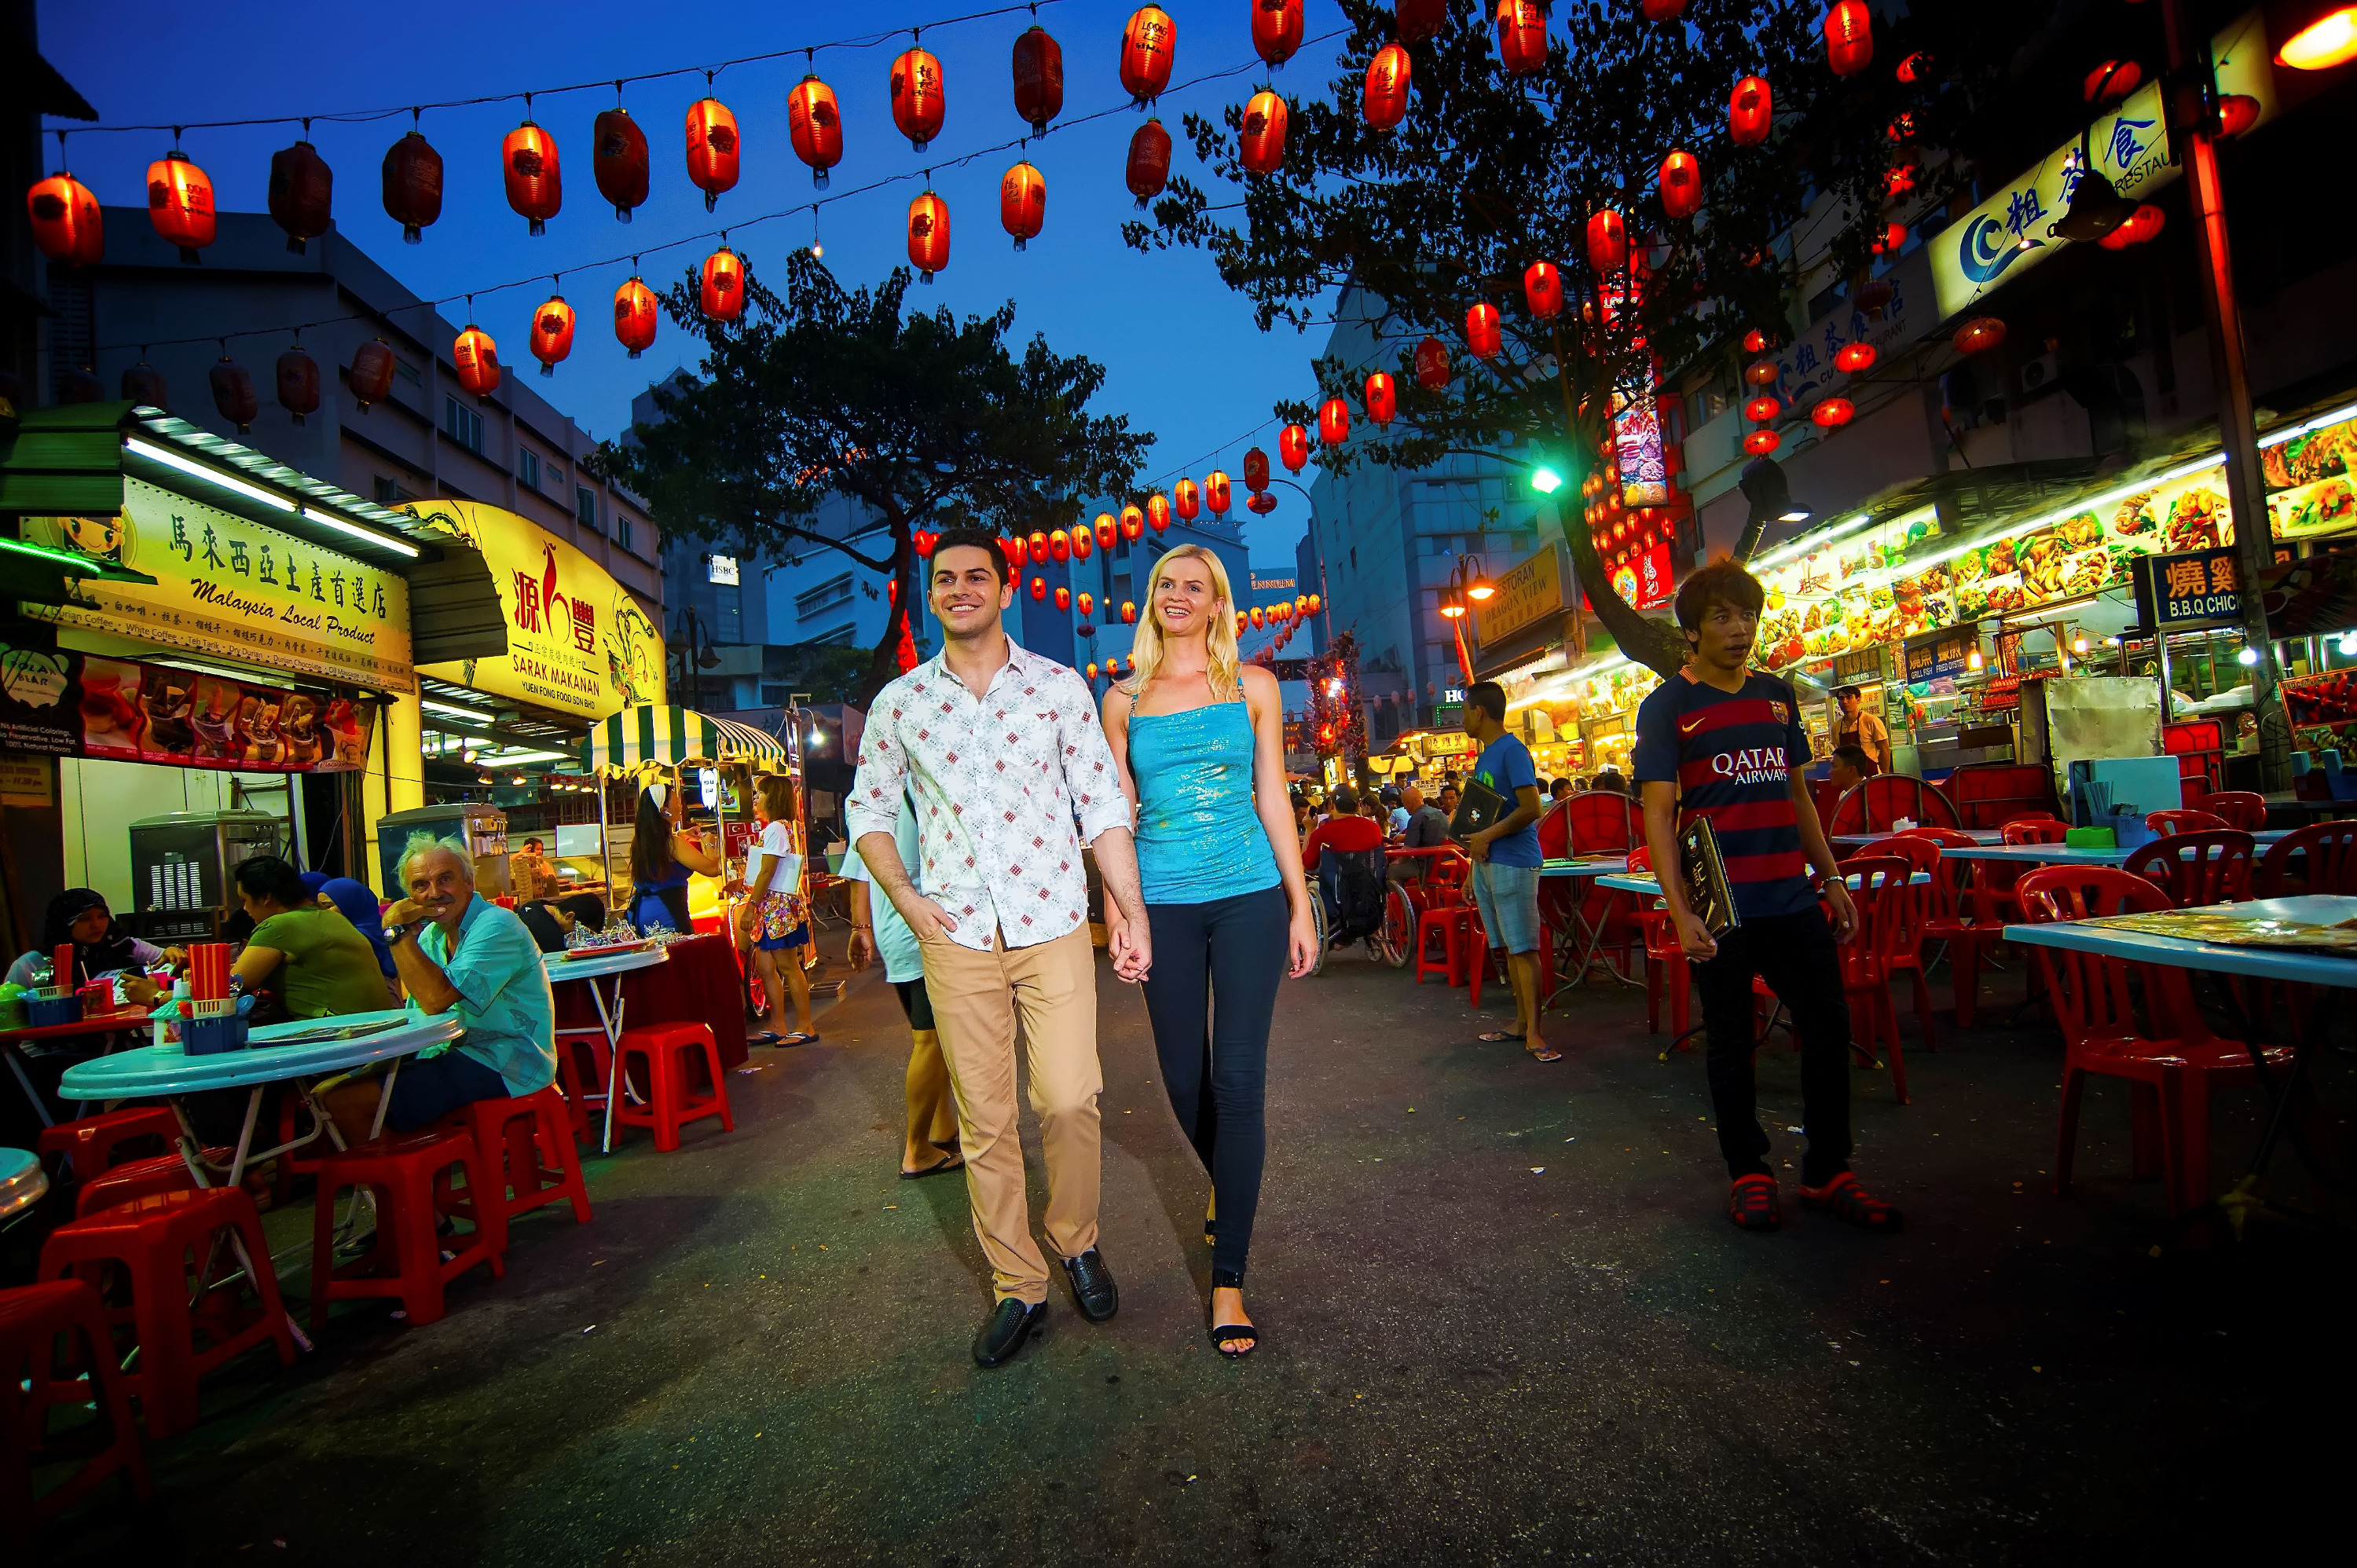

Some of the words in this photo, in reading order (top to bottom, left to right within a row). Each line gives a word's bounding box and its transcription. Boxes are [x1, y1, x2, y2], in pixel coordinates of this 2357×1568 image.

[1142, 21, 1168, 36] LOONG
[1142, 32, 1164, 45] KEE
[2114, 152, 2171, 192] RESTAU
[170, 513, 387, 619] 馬來西亞土產首選店
[712, 565, 735, 575] HSBC
[1251, 578, 1296, 590] ENNIUM
[1494, 561, 1536, 603] RESTORAN
[190, 577, 275, 617] Malaysia
[280, 605, 321, 630] Local
[326, 615, 376, 644] Product
[511, 567, 541, 634] 源
[1485, 593, 1519, 624] DRAGON
[1522, 575, 1547, 601] VIEW
[2169, 598, 2204, 617] B.B.Q
[2206, 594, 2243, 614] CHICK
[50, 606, 82, 621] Durian
[84, 614, 113, 627] Coffee
[126, 623, 149, 636] White
[152, 628, 177, 641] Coffee
[188, 636, 201, 646] Teh
[203, 639, 221, 650] Tarik
[229, 644, 241, 655] Dry
[242, 648, 262, 658] Durian
[273, 654, 293, 665] Durian
[294, 658, 322, 671] Chocolate
[18, 673, 49, 686] BEAR
[513, 654, 548, 681] SARAK
[551, 666, 599, 697] MAKANAN
[1911, 669, 1923, 680] GRILL
[1923, 667, 1933, 676] FISH
[1936, 663, 1948, 673] FRIED
[1948, 658, 1965, 670] OYSTER
[522, 680, 538, 694] YUEN
[539, 686, 555, 699] FONG
[556, 691, 572, 704] FOOD
[573, 695, 584, 706] SDN
[584, 698, 596, 710] BHD
[24, 742, 48, 751] Natural
[1712, 747, 1786, 776] QATAR
[1735, 768, 1787, 786] AIRWAYS
